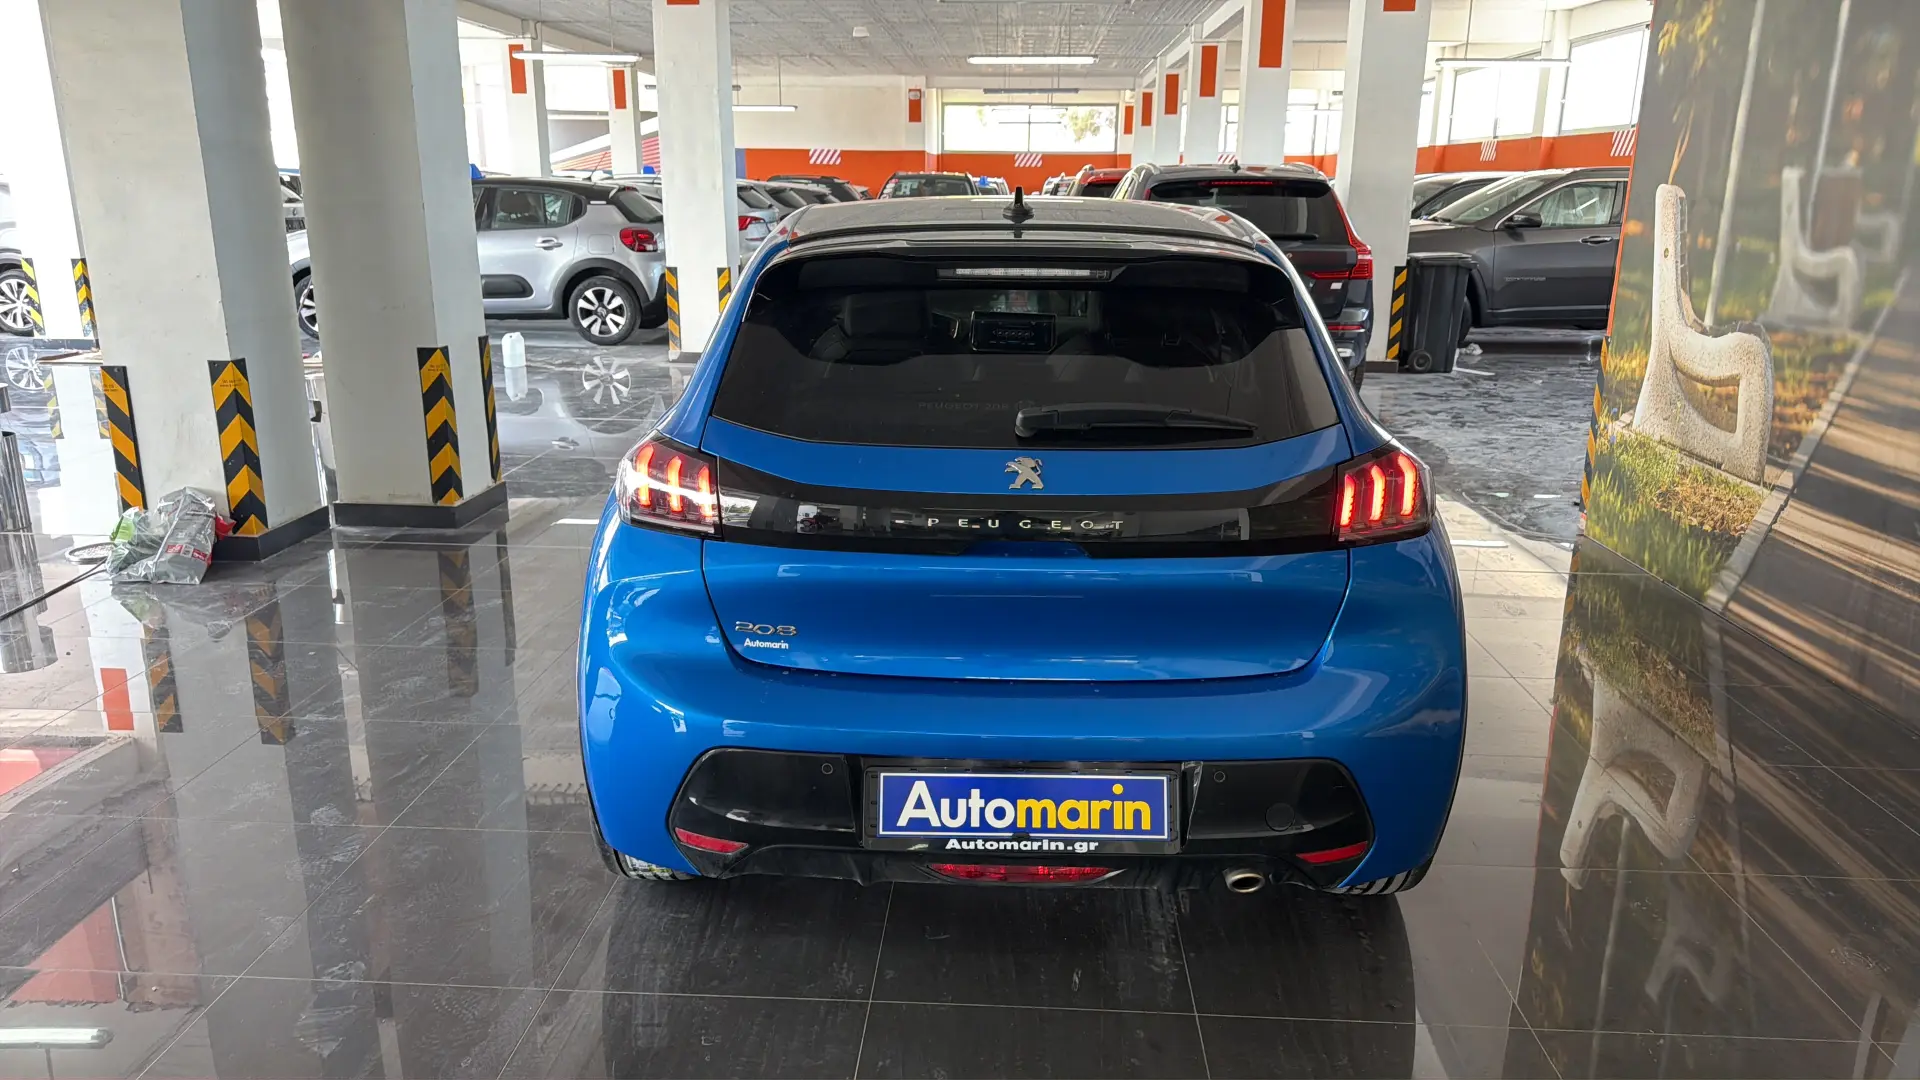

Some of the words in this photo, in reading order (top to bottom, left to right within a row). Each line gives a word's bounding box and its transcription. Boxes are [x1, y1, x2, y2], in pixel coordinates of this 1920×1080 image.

[927, 518, 1123, 529] PEUGEOT
[735, 621, 797, 636] 208
[743, 637, 789, 649] Automarin
[896, 780, 1151, 830] Automarin
[945, 838, 1099, 853] Automarin.gr
